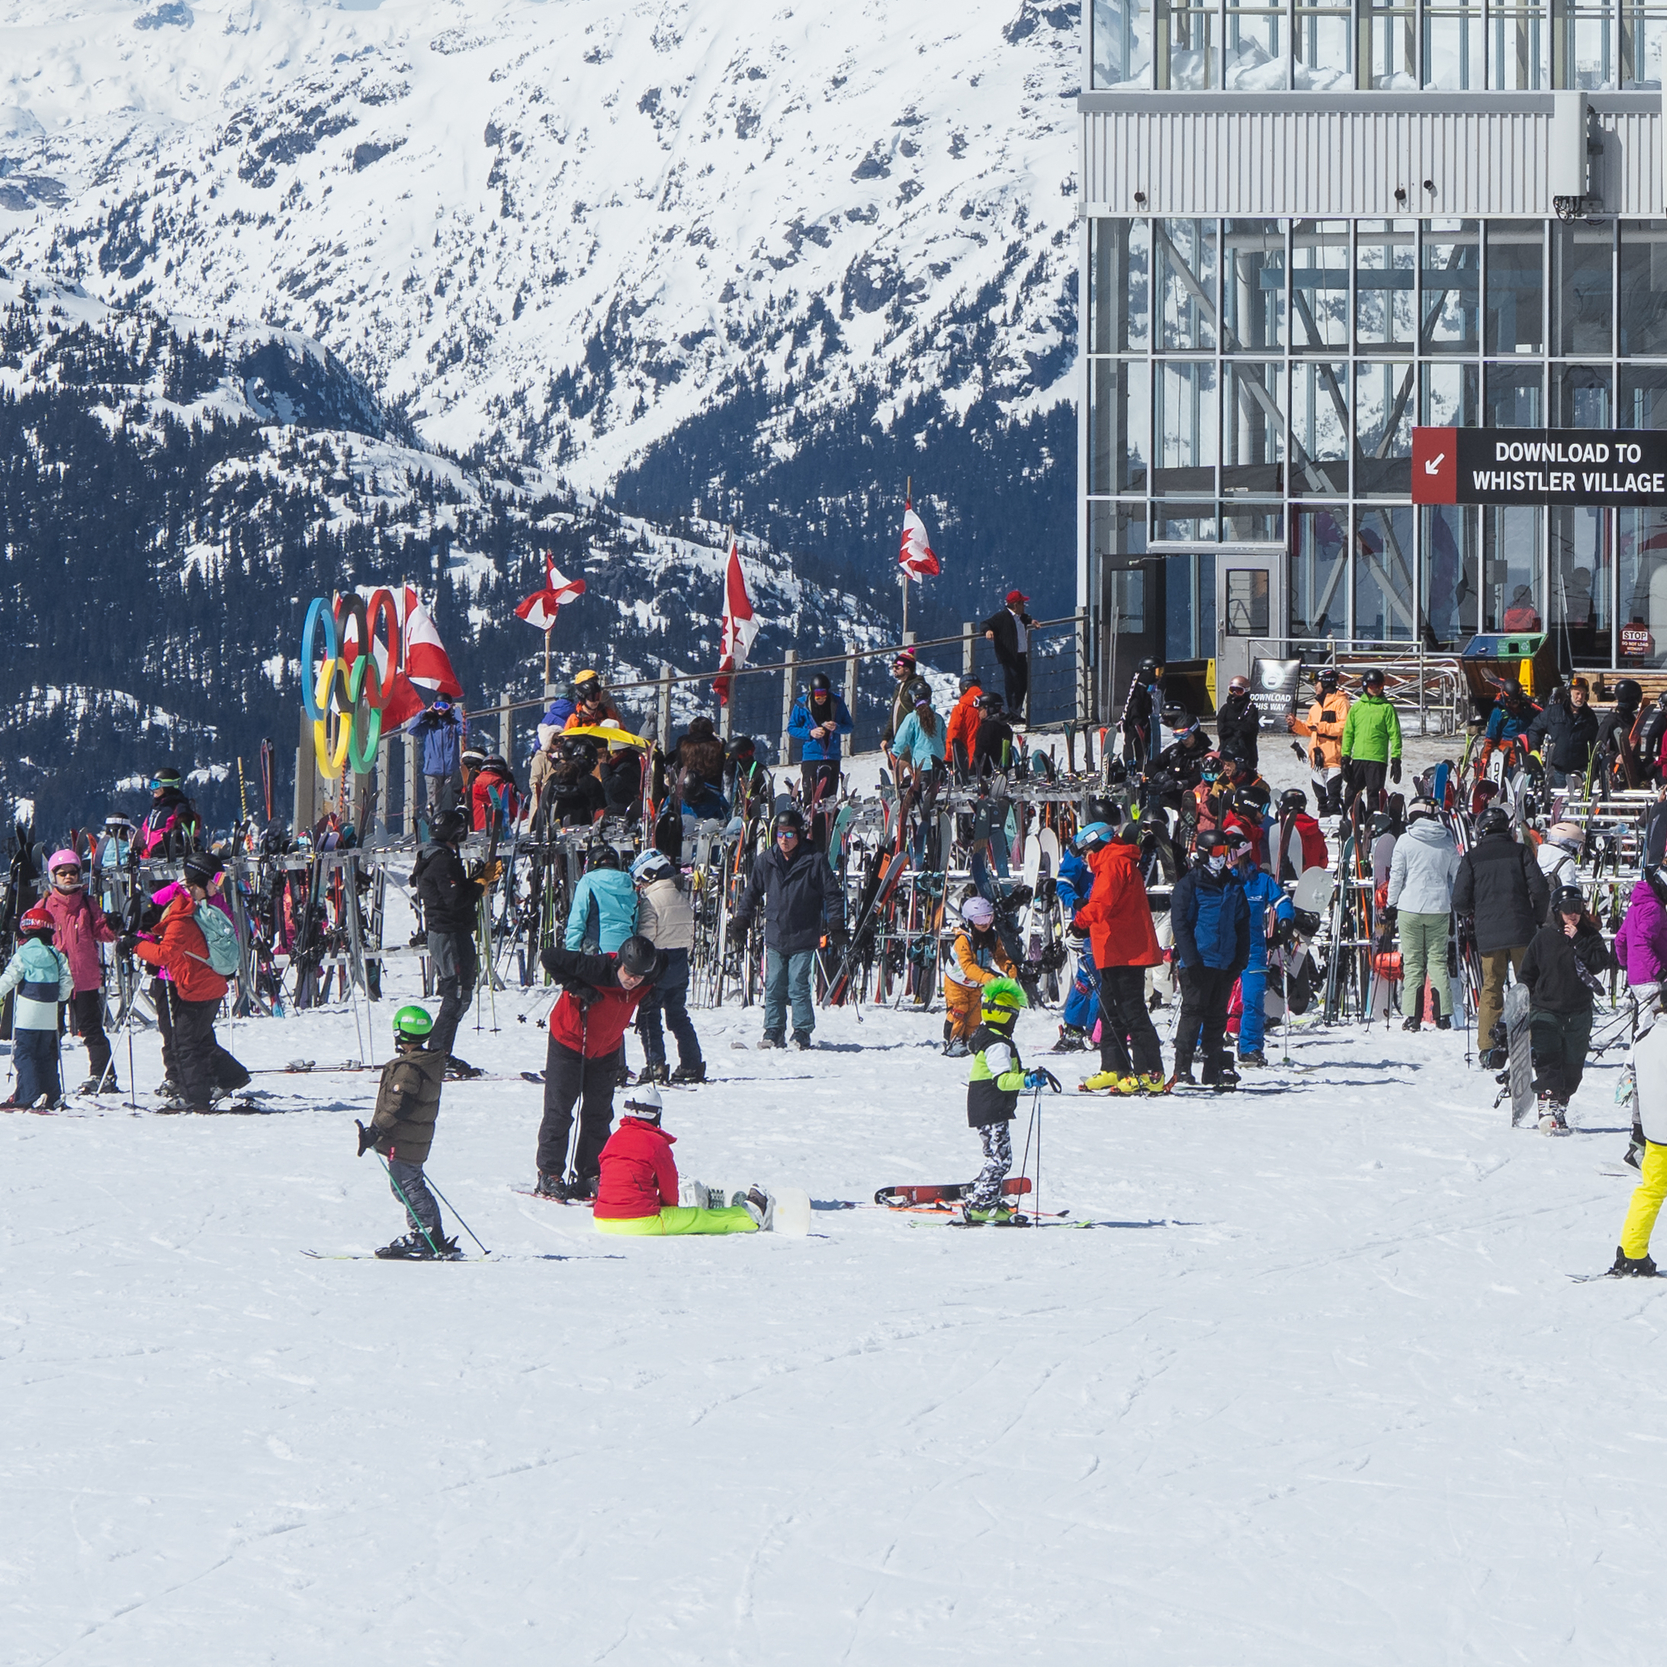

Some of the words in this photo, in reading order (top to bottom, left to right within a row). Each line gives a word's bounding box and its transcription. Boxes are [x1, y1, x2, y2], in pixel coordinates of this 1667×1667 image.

[1495, 442, 1609, 463] DOWNLOAD
[1614, 443, 1642, 464] TO
[1472, 470, 1576, 492] WHISTLER
[1582, 471, 1665, 493] VILLAGE
[1623, 631, 1647, 640] STOP
[1249, 694, 1291, 702] DOWNLOAD
[1270, 703, 1287, 711] WAY
